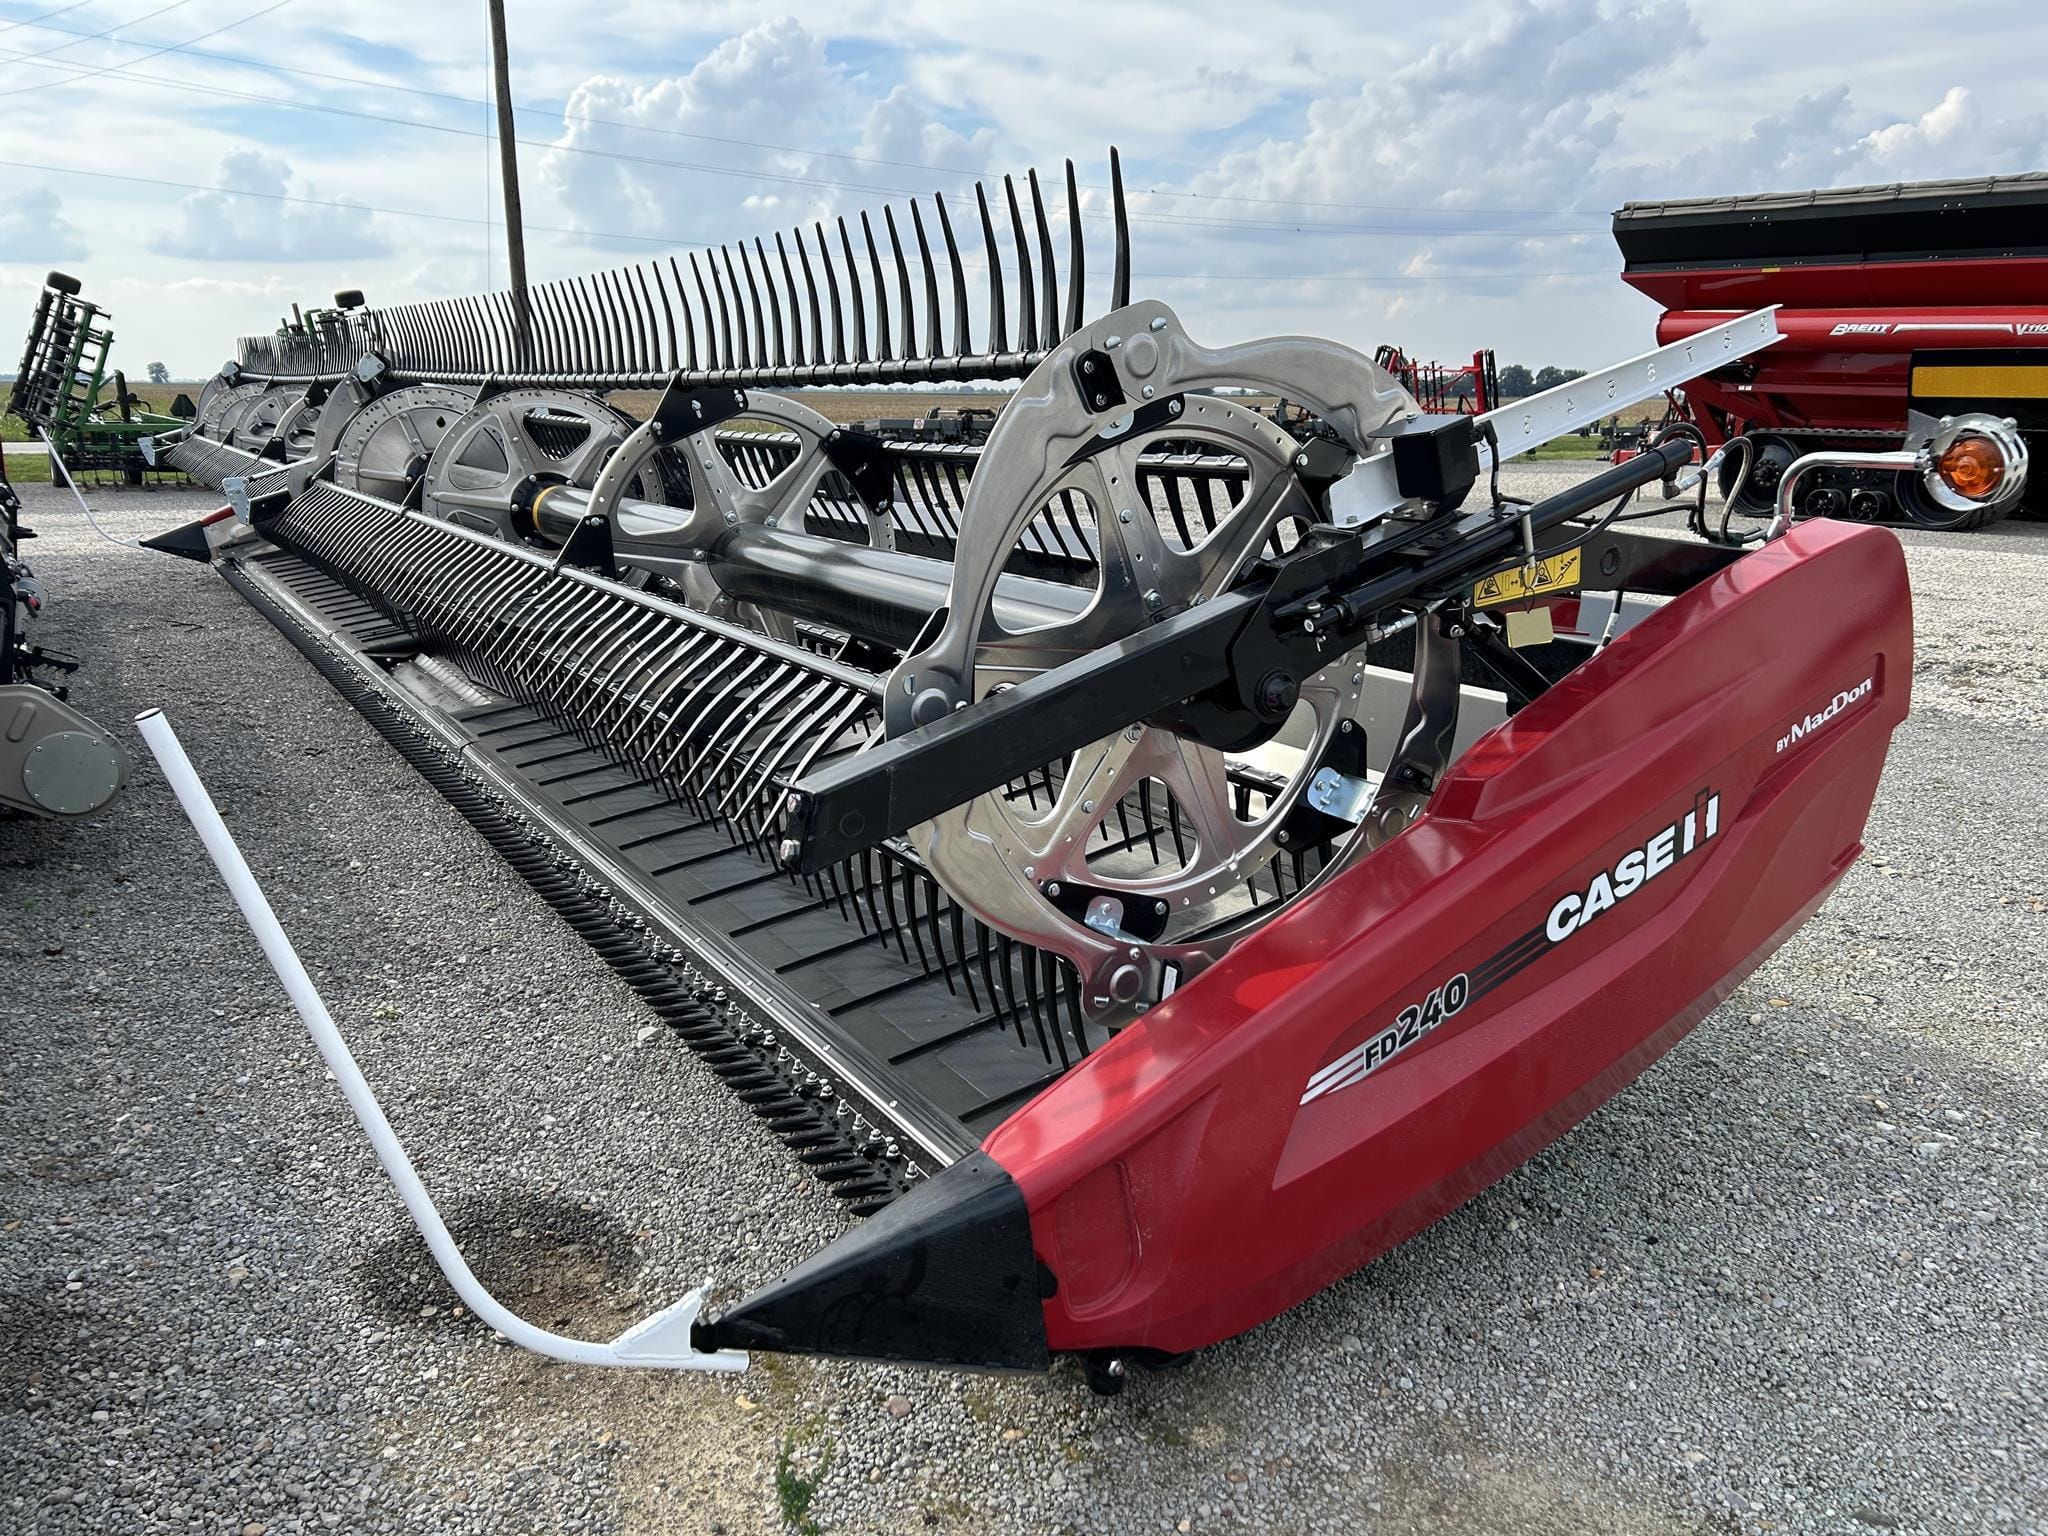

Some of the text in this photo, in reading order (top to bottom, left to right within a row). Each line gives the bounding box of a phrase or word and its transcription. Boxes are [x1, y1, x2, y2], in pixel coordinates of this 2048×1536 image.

[1776, 678, 1872, 753] BY MacDon
[1545, 824, 1676, 942] CASE
[1363, 973, 1469, 1073] FD240
